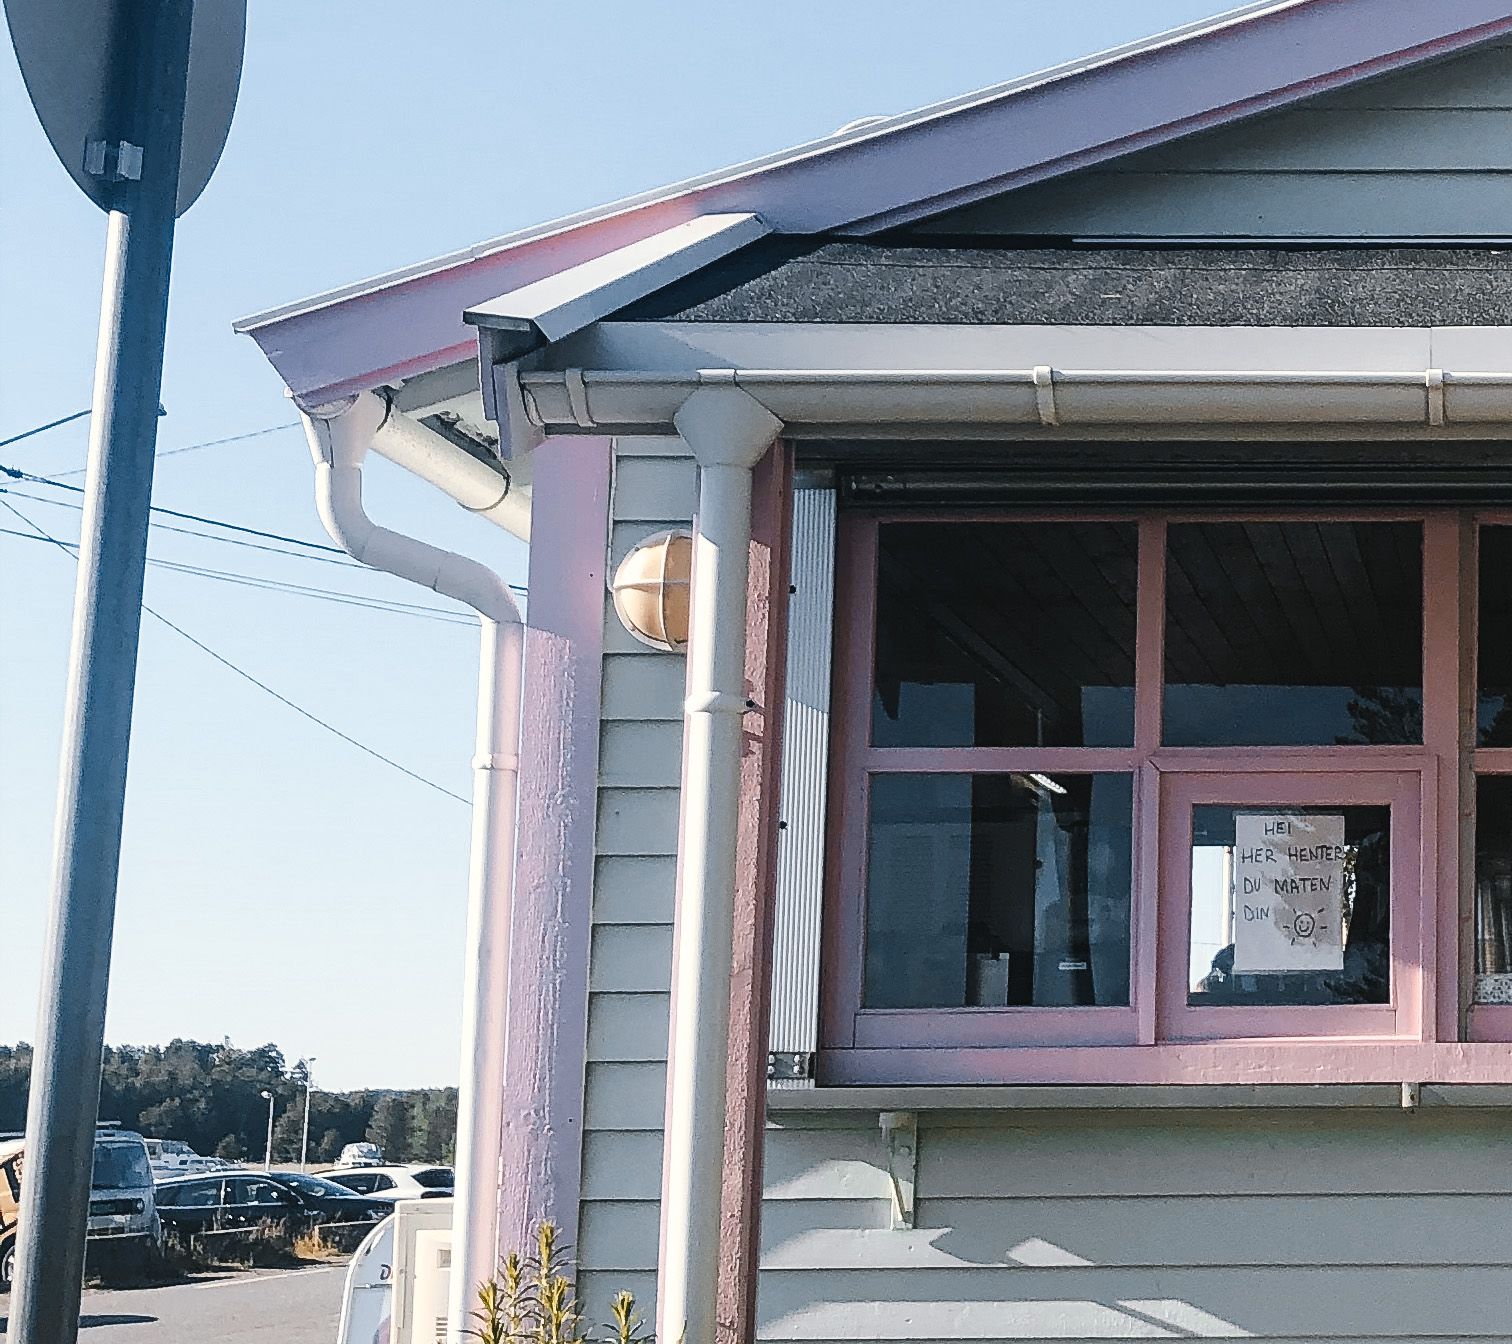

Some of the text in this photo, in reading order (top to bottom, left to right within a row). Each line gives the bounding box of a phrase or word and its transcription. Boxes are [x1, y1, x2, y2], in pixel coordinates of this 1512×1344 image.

[1264, 821, 1292, 836] HEI
[1241, 845, 1346, 864] HER HENTER
[1243, 875, 1332, 894] DU MATEN
[1243, 905, 1270, 921] DIN
